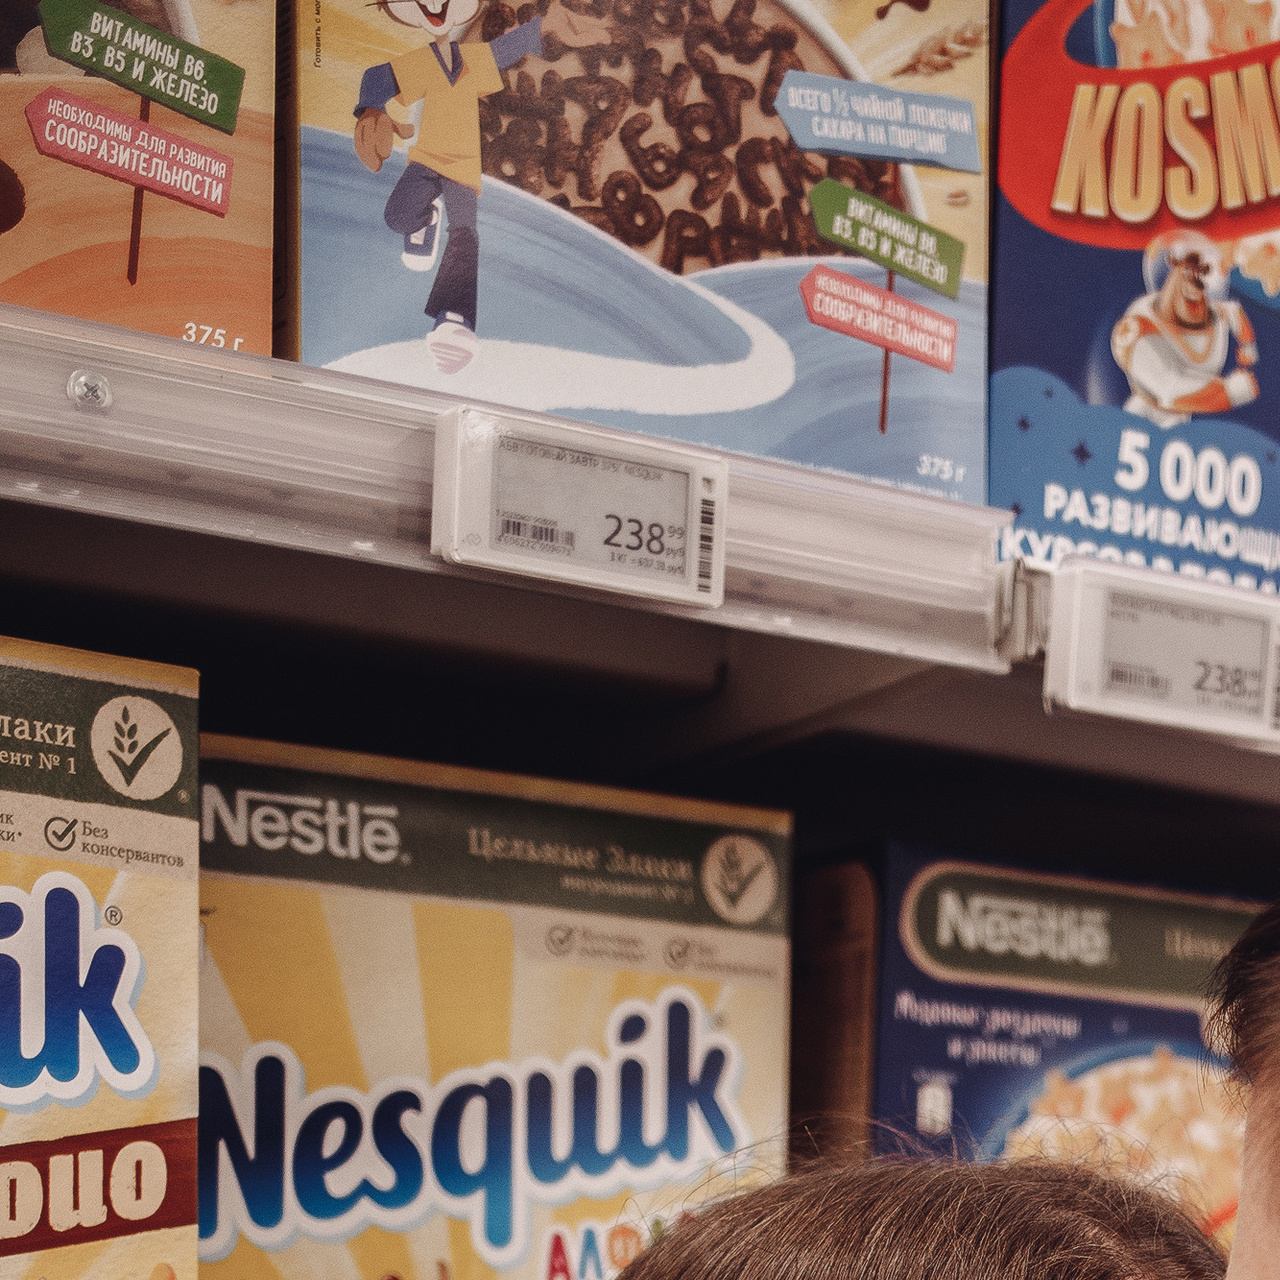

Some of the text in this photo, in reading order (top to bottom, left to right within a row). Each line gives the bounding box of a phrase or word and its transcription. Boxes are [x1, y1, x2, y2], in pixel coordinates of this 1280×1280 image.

[91, 12, 180, 68] ВИТАМИНЫ
[104, 46, 126, 72] В5
[132, 58, 145, 81] И
[150, 67, 218, 114] ЖЕЛЕЗО
[45, 119, 223, 205] СООБРАЗИТЕЛЬНОСТИ
[48, 99, 226, 178] НЕОБХОДИМЫ ДЛЯ РАЗВИТИЯ
[182, 322, 227, 348] 375
[1114, 428, 1262, 516] 5 000
[603, 513, 665, 555] 238
[39, 752, 60, 770] №
[67, 758, 77, 774] 1
[82, 821, 109, 839] Без
[82, 842, 184, 868] консервантов
[198, 1000, 737, 1249] Nesquik
